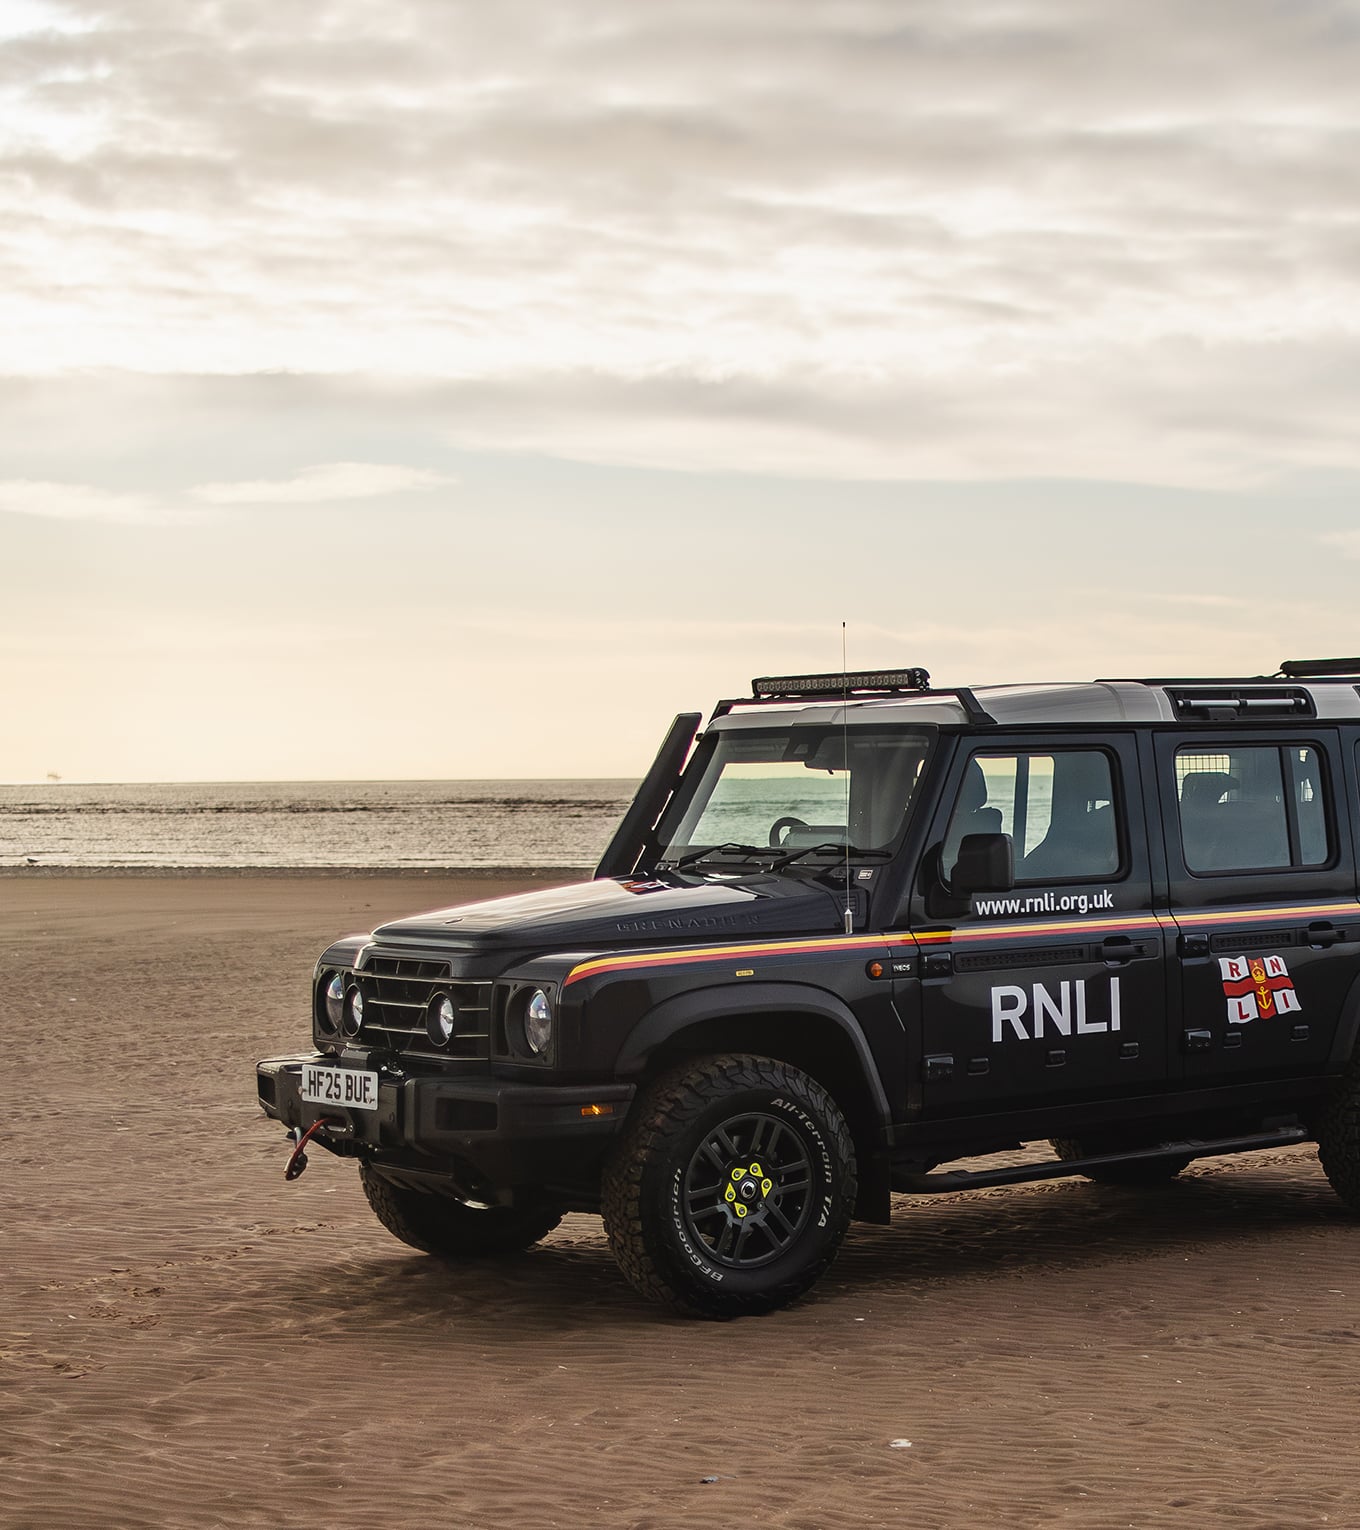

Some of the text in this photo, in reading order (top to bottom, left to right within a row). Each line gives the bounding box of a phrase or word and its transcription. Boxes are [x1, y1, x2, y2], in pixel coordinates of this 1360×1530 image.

[976, 889, 1114, 916] www.rnli.org.uk
[1228, 957, 1282, 978] R N
[991, 976, 1121, 1043] RNLI
[1237, 992, 1290, 1020] L I
[308, 1070, 341, 1100] HF25
[770, 1098, 833, 1228] All-Terrain T/A
[671, 1167, 724, 1282] BFGoodrich
